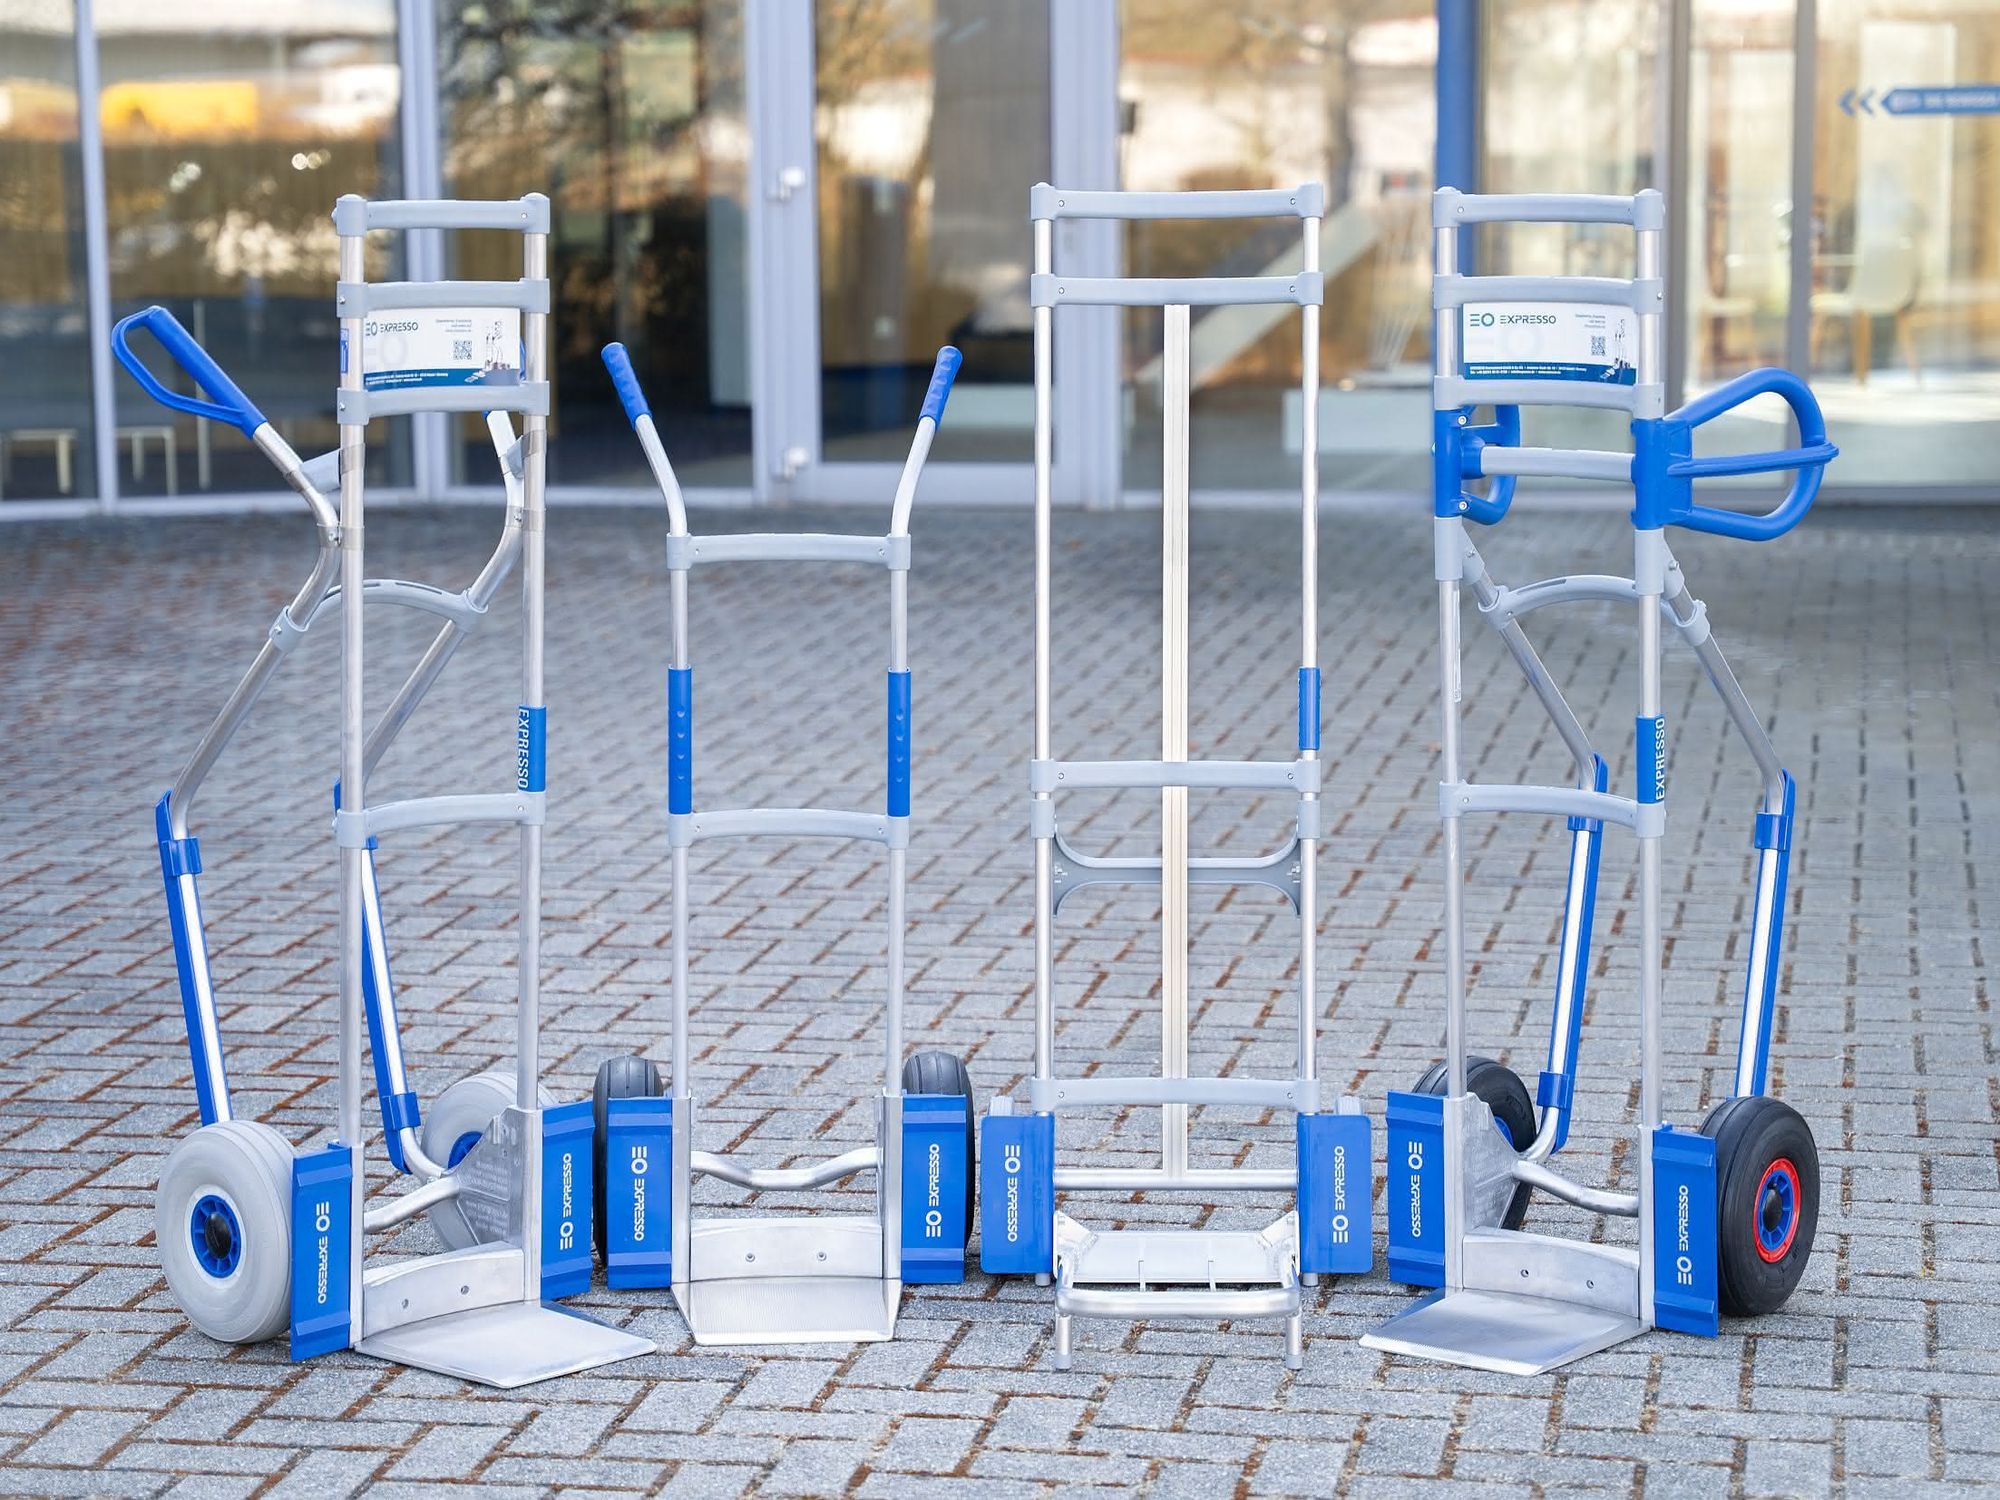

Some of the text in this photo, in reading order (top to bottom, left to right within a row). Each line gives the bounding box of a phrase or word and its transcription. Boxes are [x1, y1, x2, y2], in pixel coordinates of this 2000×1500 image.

[380, 321, 419, 334] EXPRESSO
[1499, 314, 1557, 325] EXPRESSO
[517, 708, 530, 789] EXPRESSO
[1655, 717, 1665, 801] EXPRESSO
[562, 1152, 572, 1218] EXPRESSO
[928, 1143, 940, 1207] EXPRESSO
[1334, 1145, 1345, 1211] EXPRESSO
[1410, 1174, 1422, 1238] EXPRESSO
[634, 1178, 645, 1241] EXPRESSO
[1007, 1177, 1018, 1242] EXPRESSO
[1679, 1185, 1689, 1251] EXPRESSO
[317, 1235, 328, 1304] EXPRESSO
